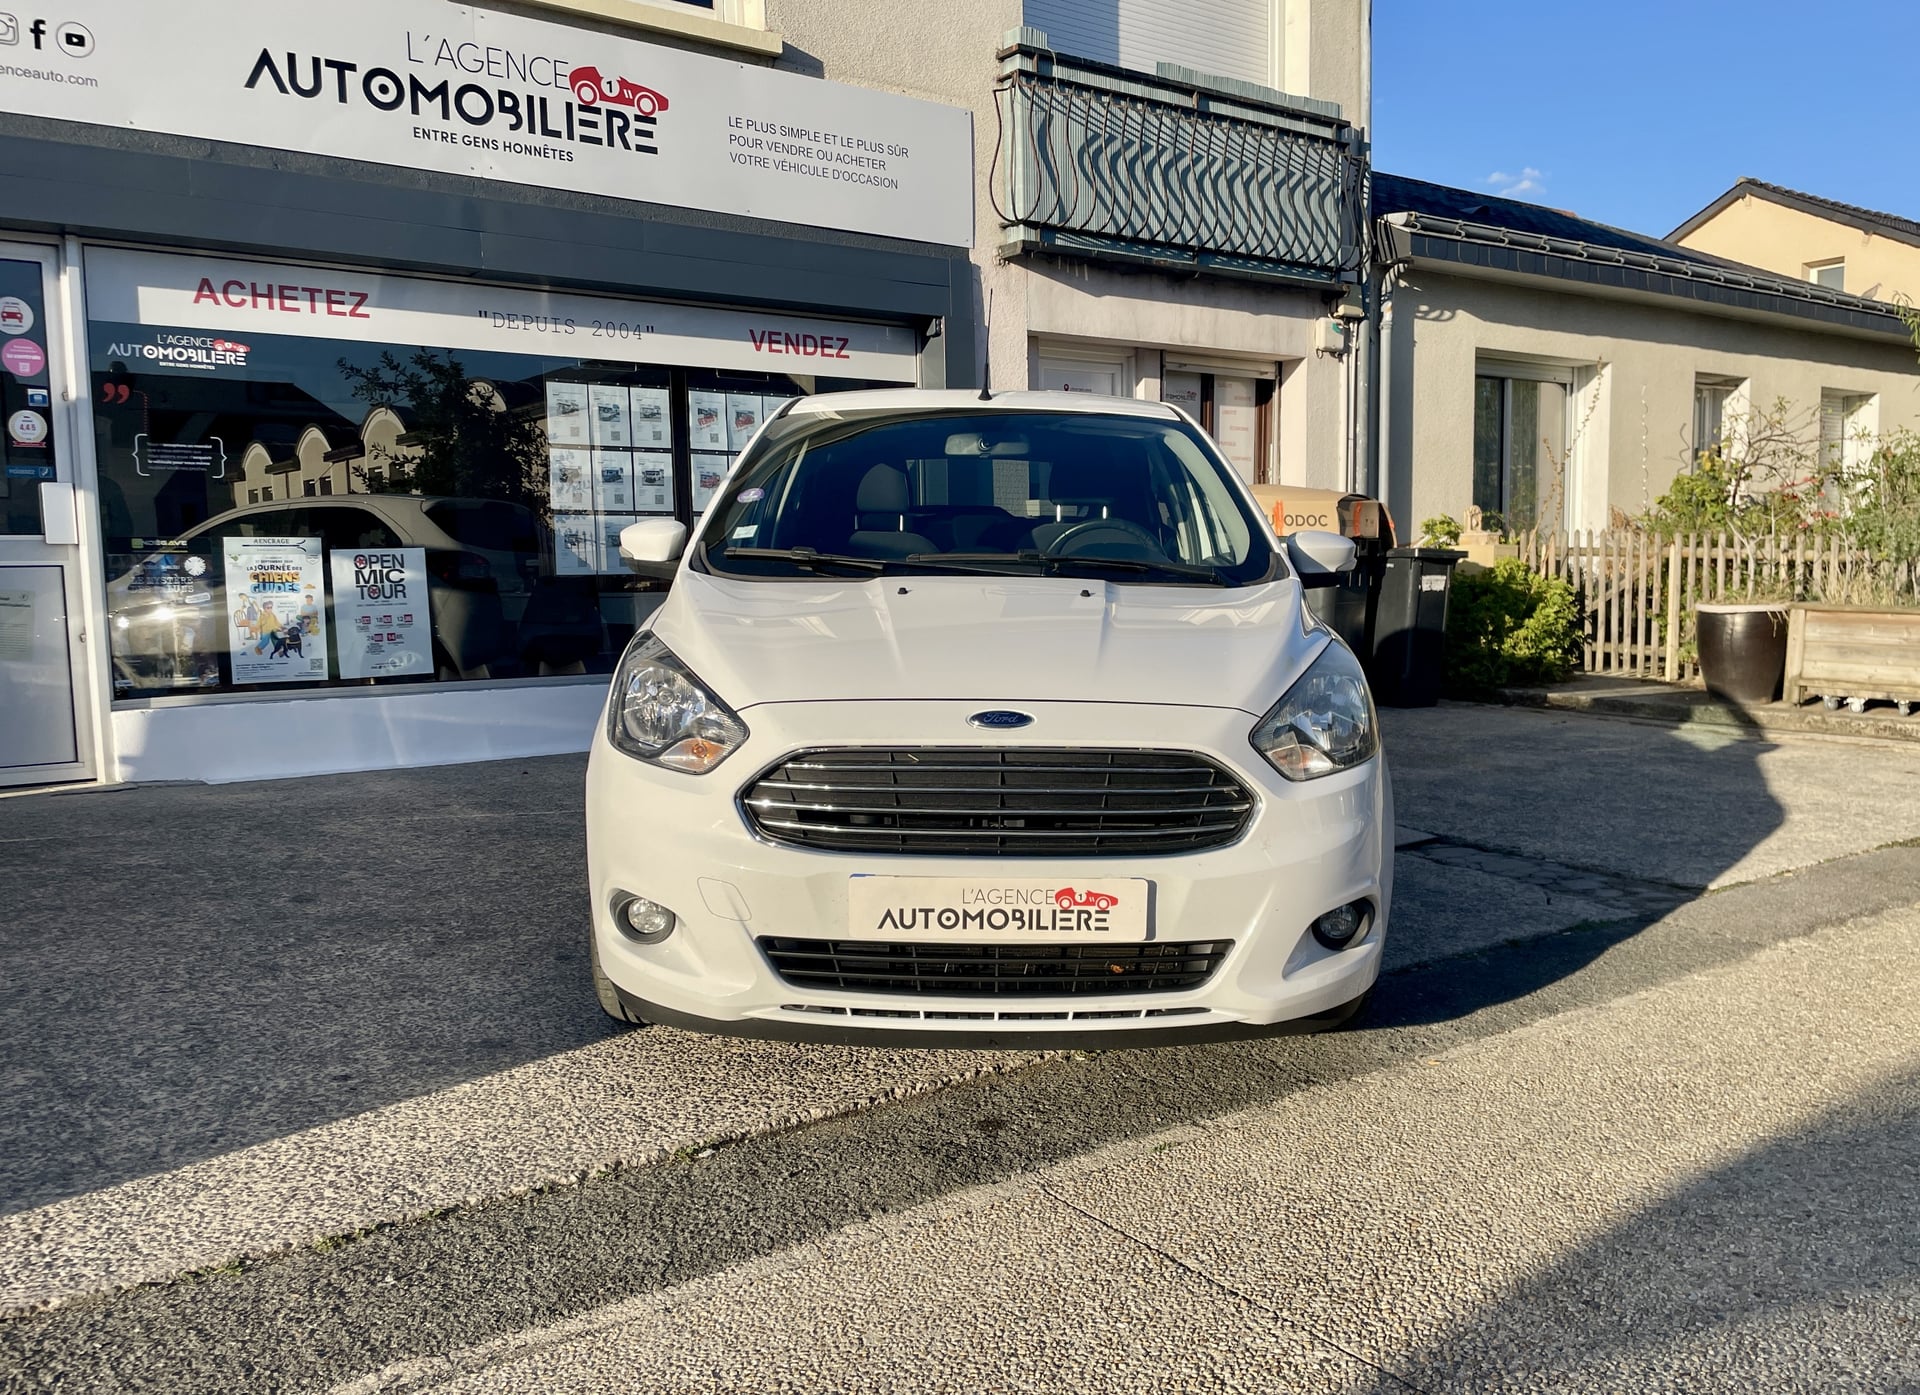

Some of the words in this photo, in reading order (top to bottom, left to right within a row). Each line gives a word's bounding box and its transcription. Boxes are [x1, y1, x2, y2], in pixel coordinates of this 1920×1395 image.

[407, 31, 570, 91] L'AGENCE
[413, 126, 458, 144] ENTRE
[462, 134, 499, 151] GENS
[503, 141, 574, 162] HONNÊTES
[728, 116, 743, 129] LE
[746, 119, 777, 135] PLUS
[779, 125, 821, 143] SIMPLE
[824, 133, 838, 146] ET
[840, 136, 854, 149] LE
[857, 139, 884, 154] PLUS
[887, 144, 909, 159] SÛR
[729, 134, 764, 150] POUR
[766, 140, 814, 159] VENDRE
[816, 149, 833, 162] OU
[835, 152, 886, 171] ACHETER
[729, 152, 770, 169] VOTRE
[773, 158, 829, 179] VÉHICULE
[832, 169, 898, 190] D'OCCASION
[193, 277, 371, 319] ACHETEZ
[157, 334, 214, 349] L'AGENCE
[748, 328, 850, 359] VENDEZ
[354, 553, 405, 569] OPEN
[249, 572, 300, 583] CHIENS
[354, 569, 405, 584] MIC
[250, 582, 301, 593] GUIDES
[355, 584, 407, 600] TOUR
[983, 712, 1019, 723] Ford
[962, 888, 1056, 905] L'AGENCE
